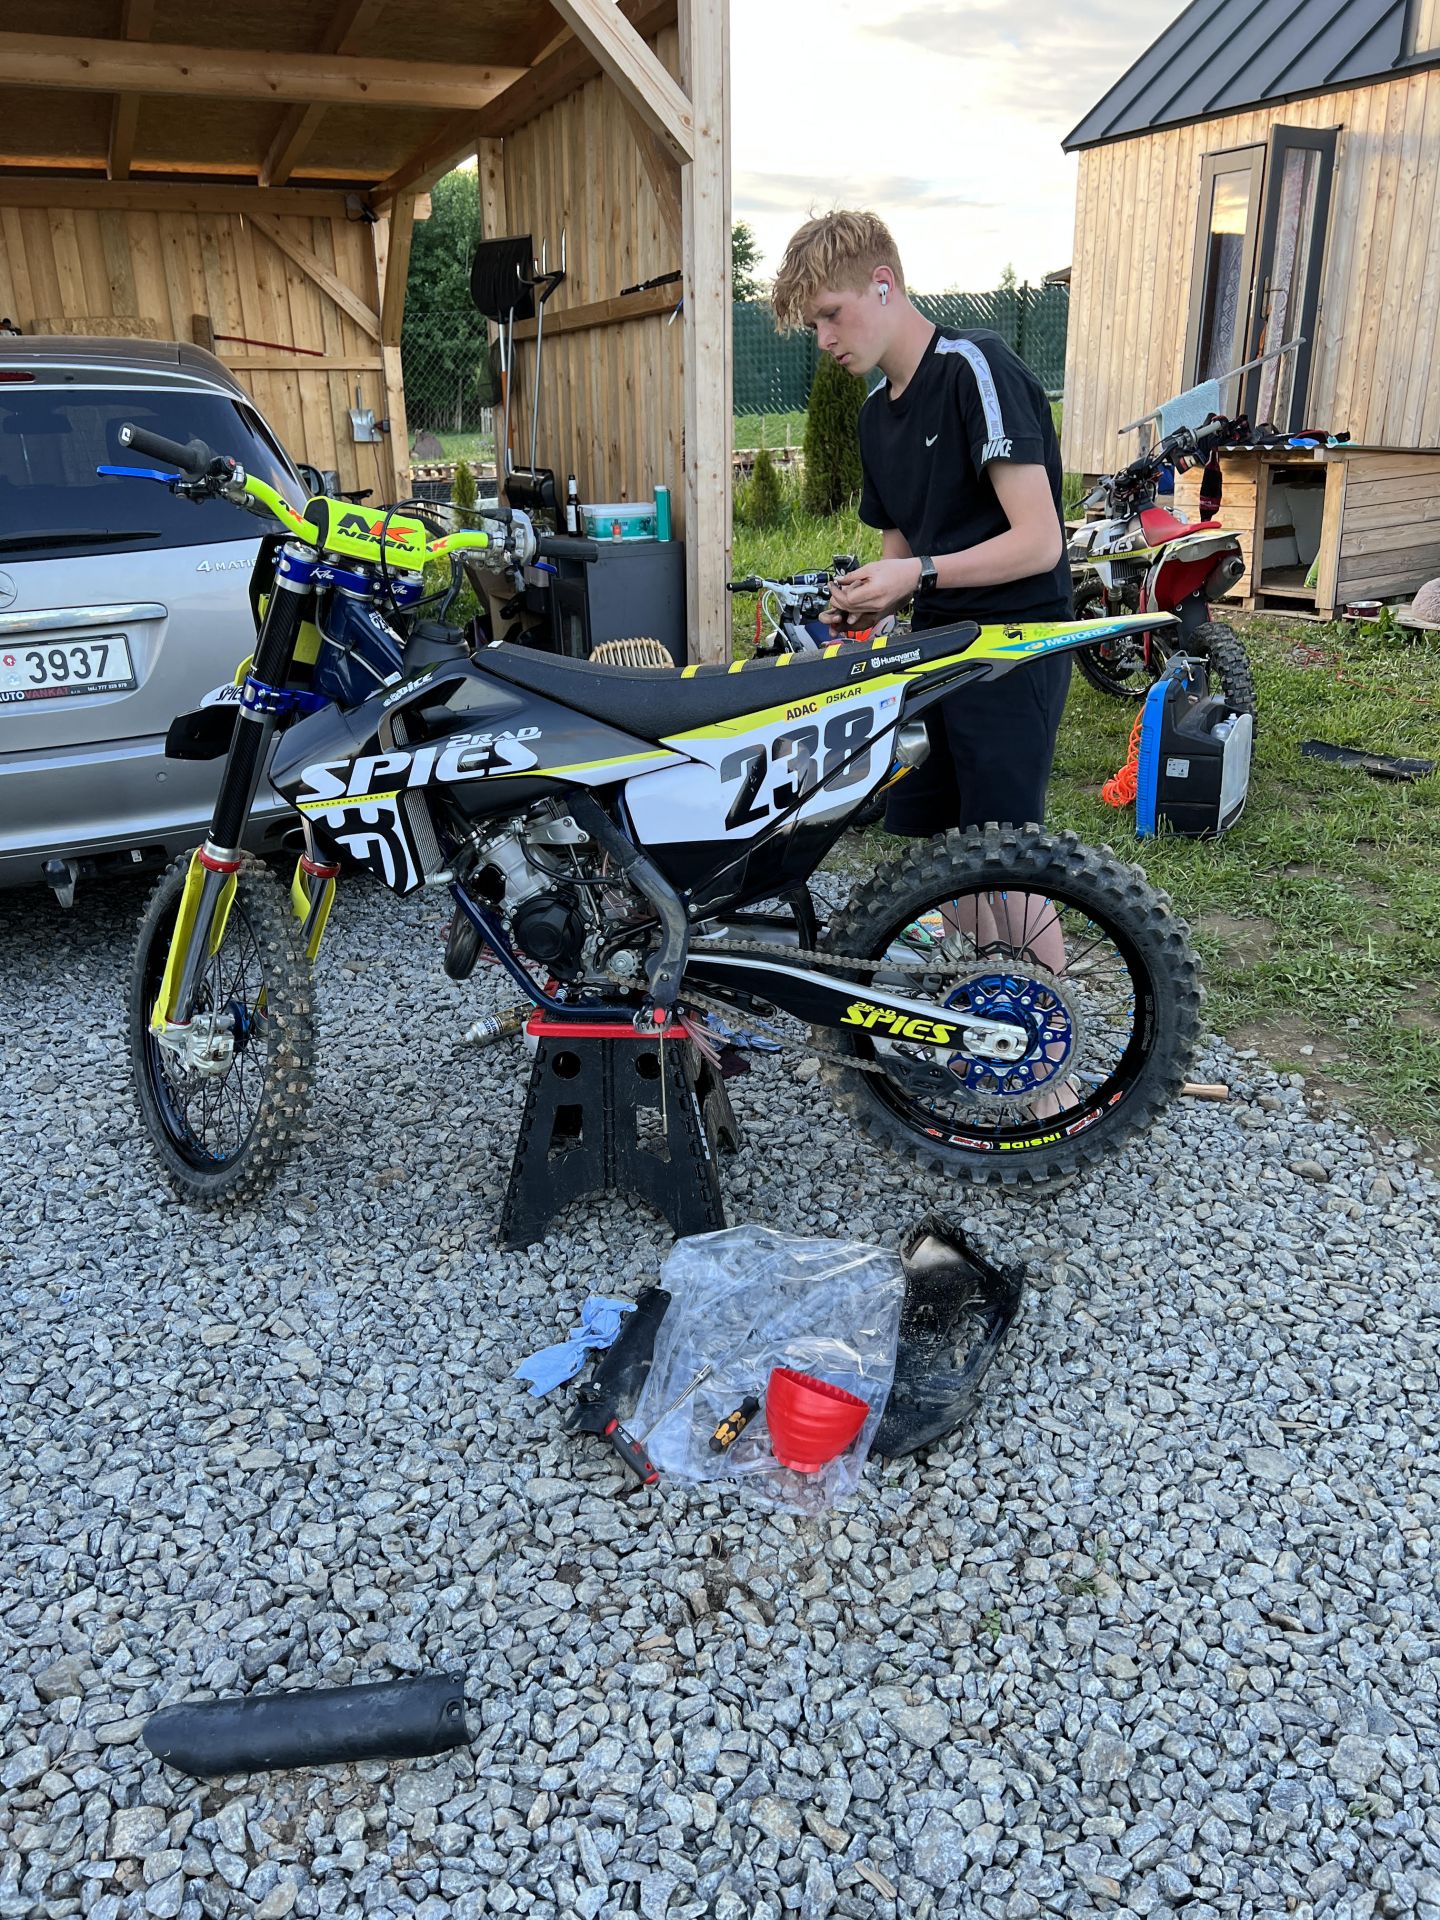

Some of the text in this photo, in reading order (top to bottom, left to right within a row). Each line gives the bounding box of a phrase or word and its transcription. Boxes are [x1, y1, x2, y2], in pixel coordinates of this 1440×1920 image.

[981, 438, 1013, 464] NIKE
[337, 528, 415, 553] NEKEN
[1045, 624, 1119, 648] MOTOREX
[25, 644, 110, 684] 3937
[880, 648, 920, 666] Husqvarna
[786, 686, 863, 721] ADAC OSKAR
[446, 726, 543, 749] 2RAD
[296, 739, 540, 803] SPIES
[719, 706, 875, 832] 238
[852, 1001, 897, 1016] 2RAD
[840, 1005, 958, 1044] SPIES
[999, 1132, 1062, 1150] INSIDE
